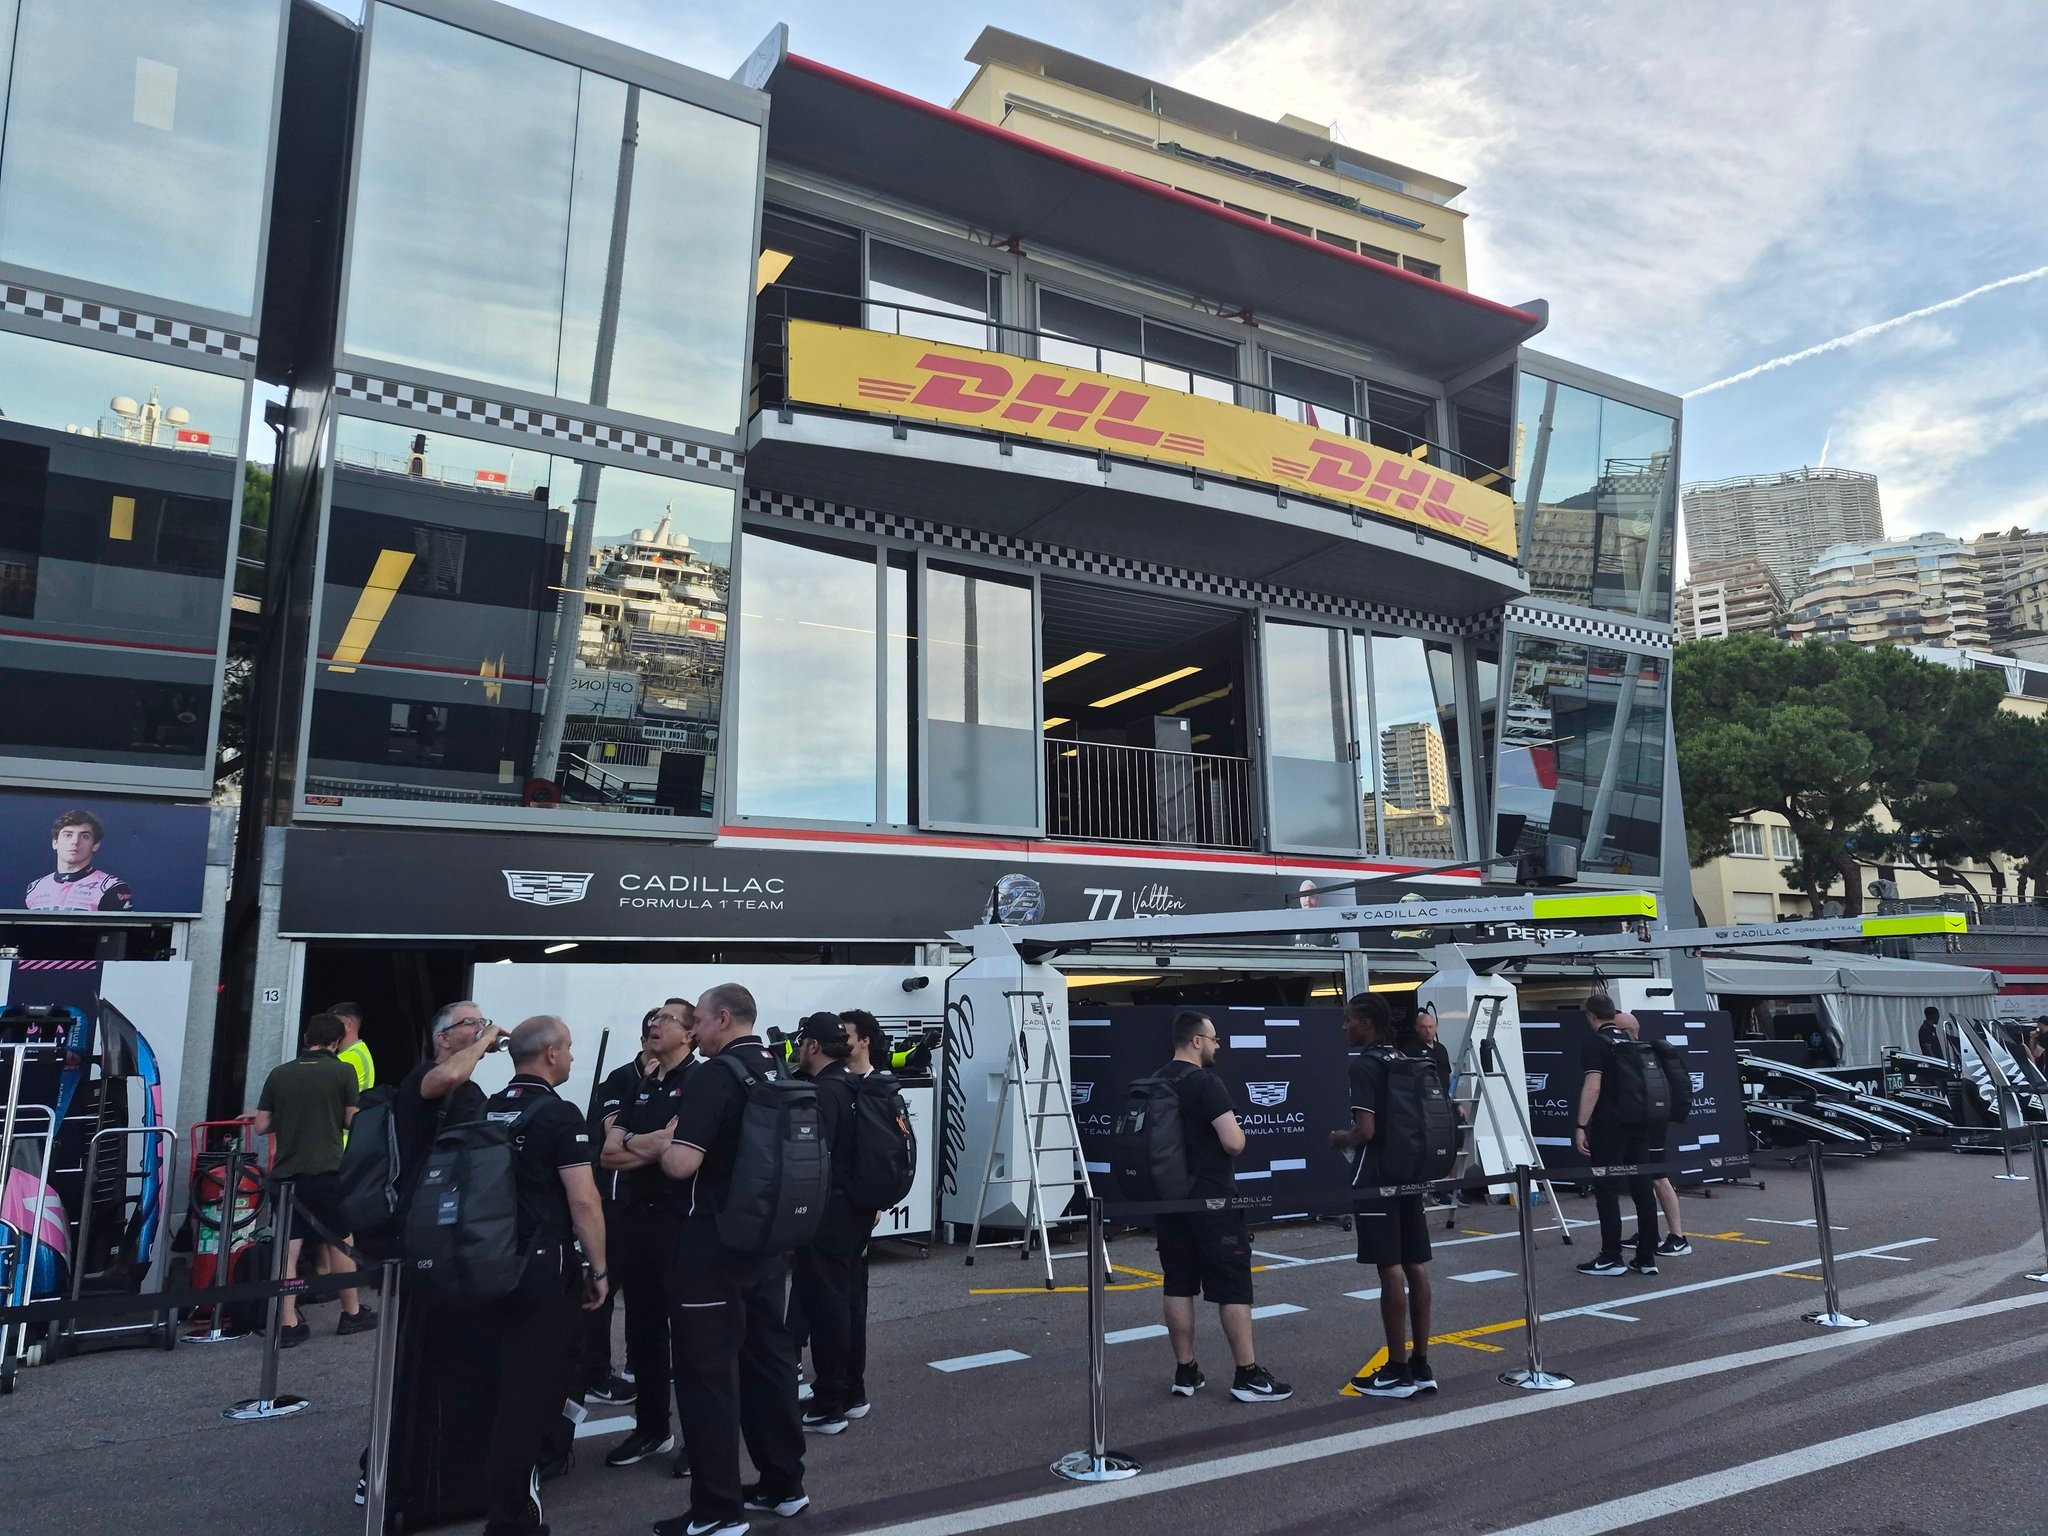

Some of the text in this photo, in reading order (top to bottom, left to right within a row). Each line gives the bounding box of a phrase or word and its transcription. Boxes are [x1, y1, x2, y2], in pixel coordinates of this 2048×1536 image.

[910, 353, 1165, 447] DHL
[1306, 438, 1465, 527] DHL
[619, 873, 785, 894] CADILLAC
[619, 897, 713, 909] FORMULA
[734, 899, 784, 910] TEAM
[1083, 887, 1123, 921] 77
[1132, 883, 1188, 914] Valtteri
[1363, 907, 1439, 920] CADILLAC
[1445, 906, 1490, 915] FORMULA
[1507, 926, 1577, 940] PEREZ
[1732, 927, 1791, 938] CADILLAC
[264, 990, 279, 1002] 13
[1886, 1076, 1903, 1089] TAG
[942, 994, 974, 1196] Cadillac
[1234, 1112, 1305, 1126] CADILLAC
[1083, 1128, 1111, 1136] TEAM
[1401, 1182, 1436, 1191] CADILLAC
[1231, 1195, 1273, 1204] CADILLAC
[889, 1205, 910, 1230] 11
[417, 1259, 433, 1269] 029
